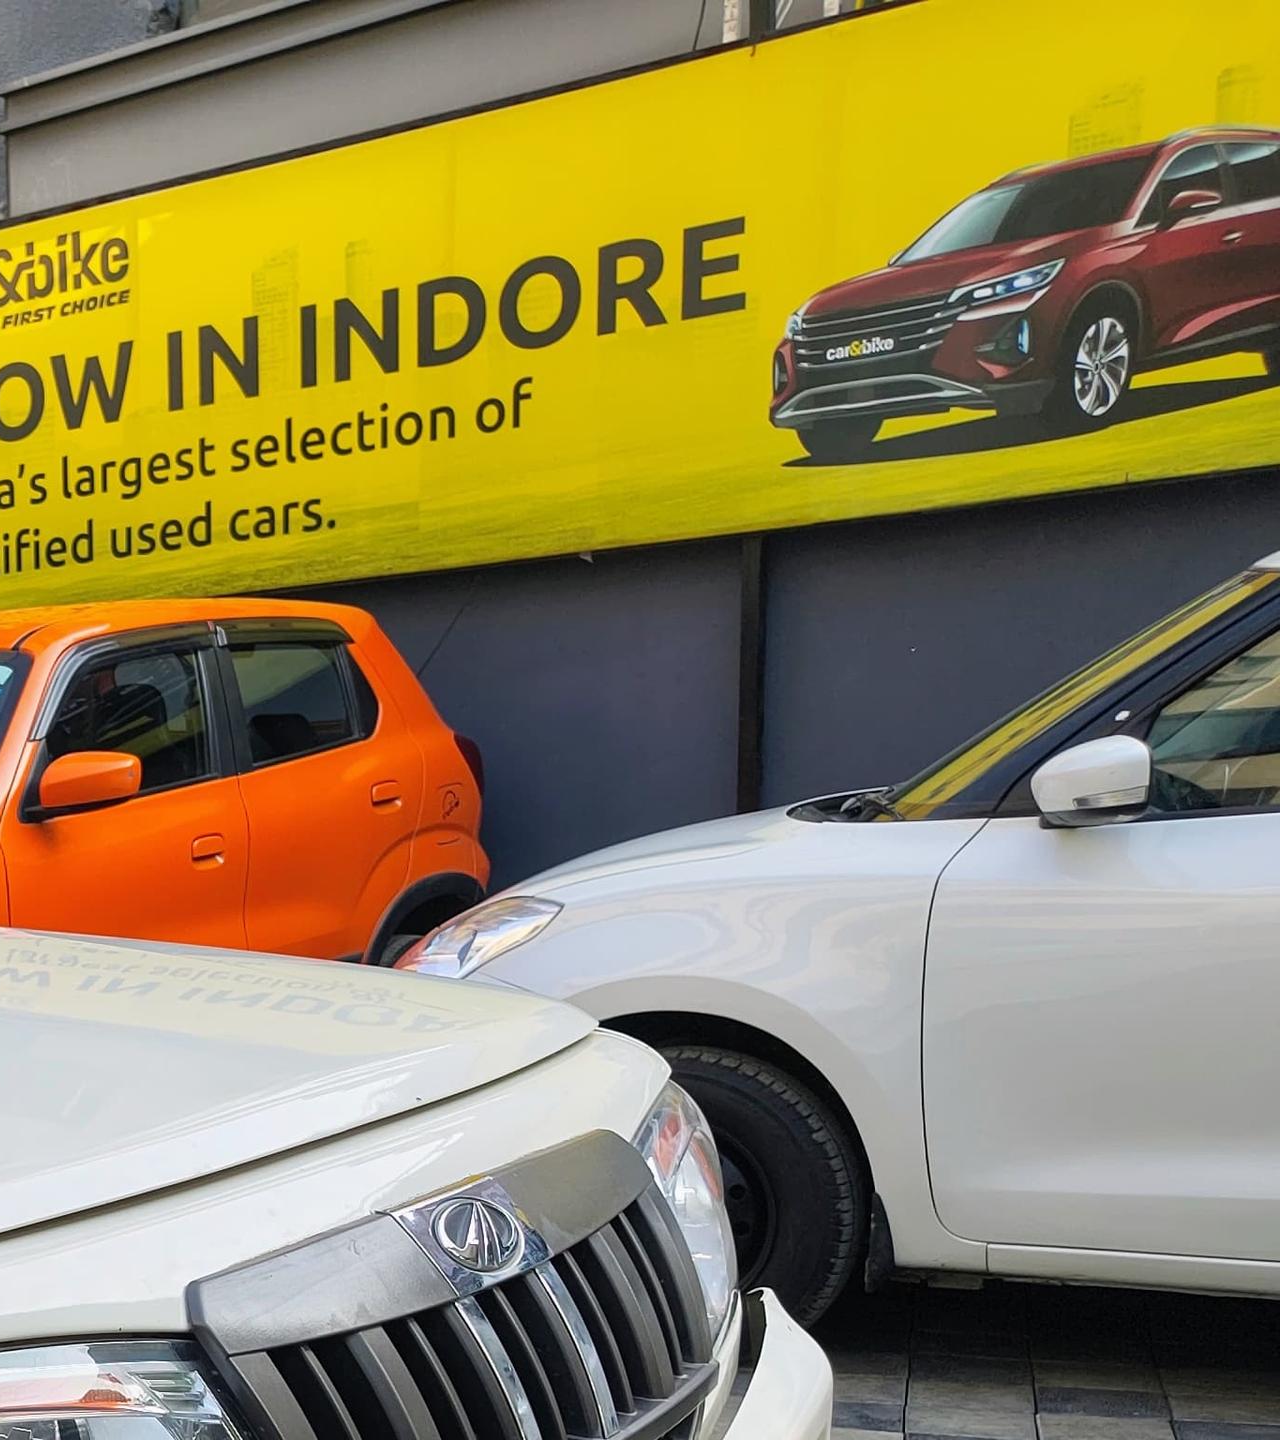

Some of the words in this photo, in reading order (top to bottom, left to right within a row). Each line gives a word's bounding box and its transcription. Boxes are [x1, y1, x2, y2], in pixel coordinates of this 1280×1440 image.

[1, 306, 56, 329] FIRST
[59, 289, 131, 317] CHOICE
[166, 315, 260, 412] IN
[299, 216, 747, 389] INDORE
[825, 336, 895, 361] car&bike
[61, 437, 215, 500] largest
[230, 403, 457, 472] selection
[475, 377, 533, 434] of
[110, 502, 213, 560] used
[228, 498, 337, 542] cars.
